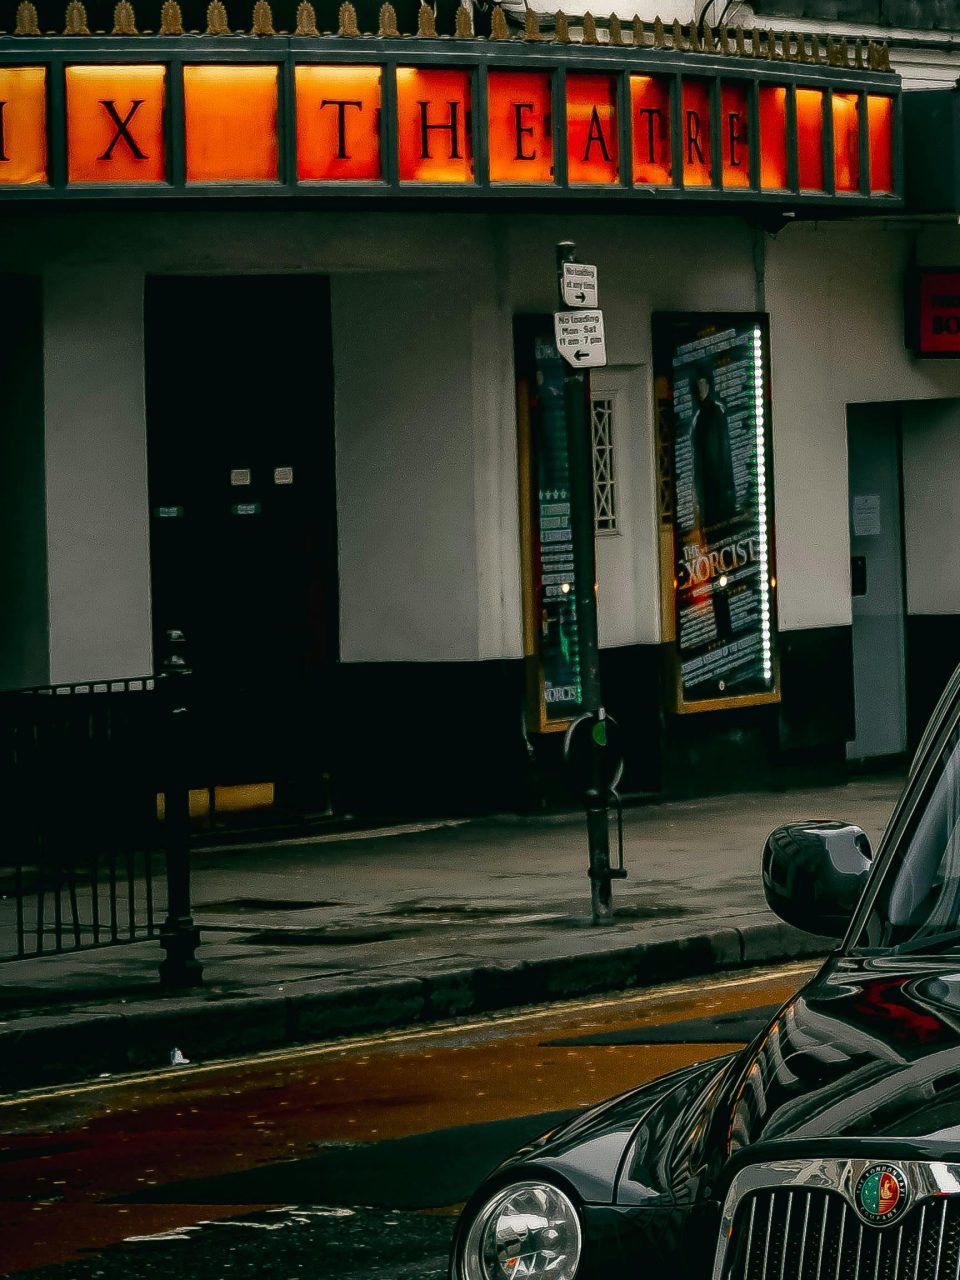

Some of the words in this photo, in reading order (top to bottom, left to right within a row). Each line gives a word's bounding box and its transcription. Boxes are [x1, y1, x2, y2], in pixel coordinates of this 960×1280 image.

[319, 99, 741, 167] THEATRE
[558, 316, 570, 325] No
[571, 314, 600, 325] loading
[561, 327, 579, 336] Mon
[583, 325, 597, 334] Sat
[583, 336, 589, 345] 7
[590, 336, 602, 346] pm
